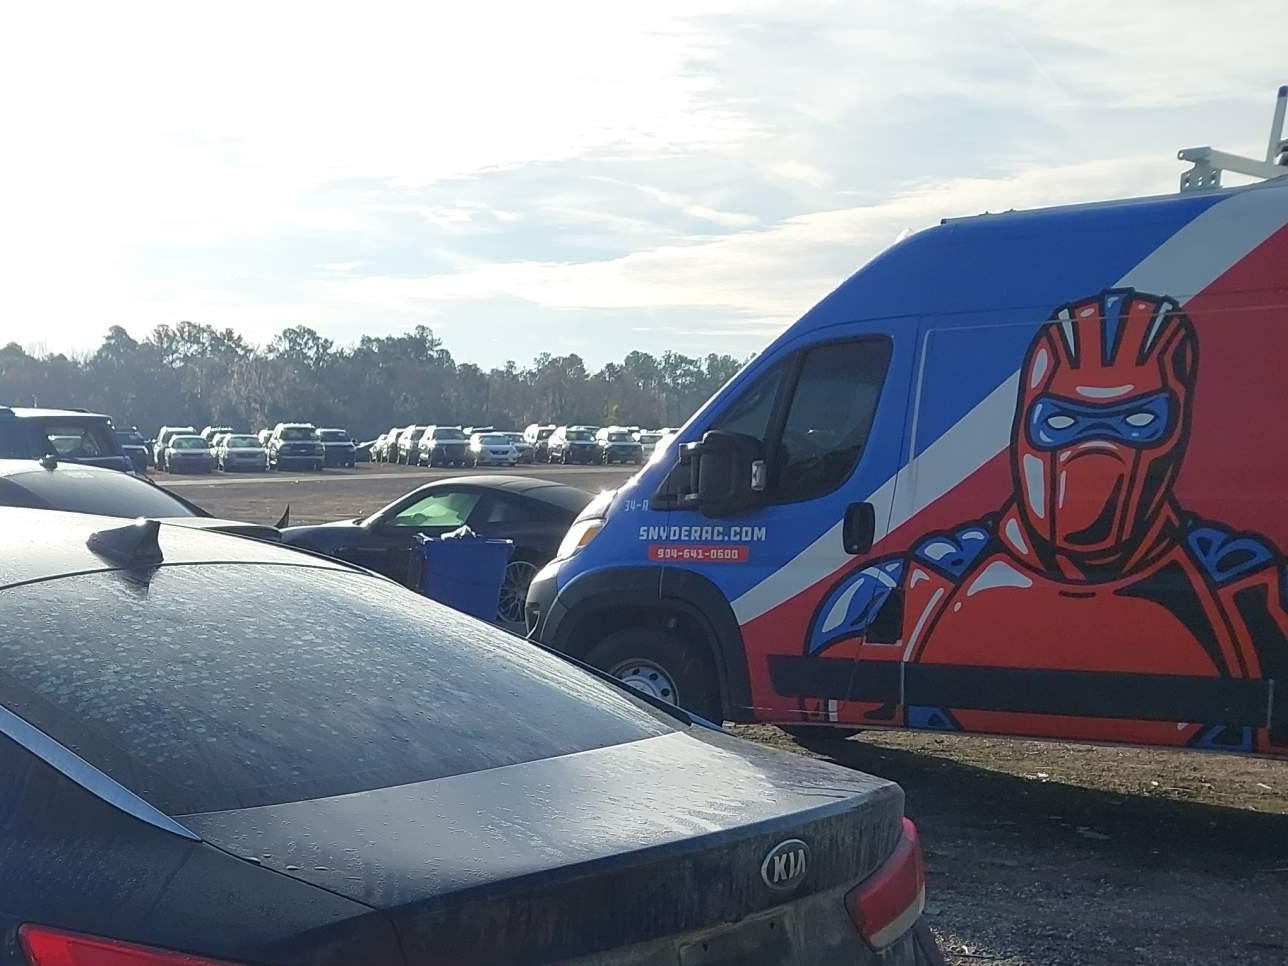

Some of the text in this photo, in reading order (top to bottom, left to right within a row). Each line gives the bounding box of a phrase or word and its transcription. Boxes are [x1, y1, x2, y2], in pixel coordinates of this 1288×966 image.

[639, 526, 767, 541] SNYDERAC.COM
[657, 548, 739, 560] 904-641-0600
[773, 849, 806, 882] KIA
